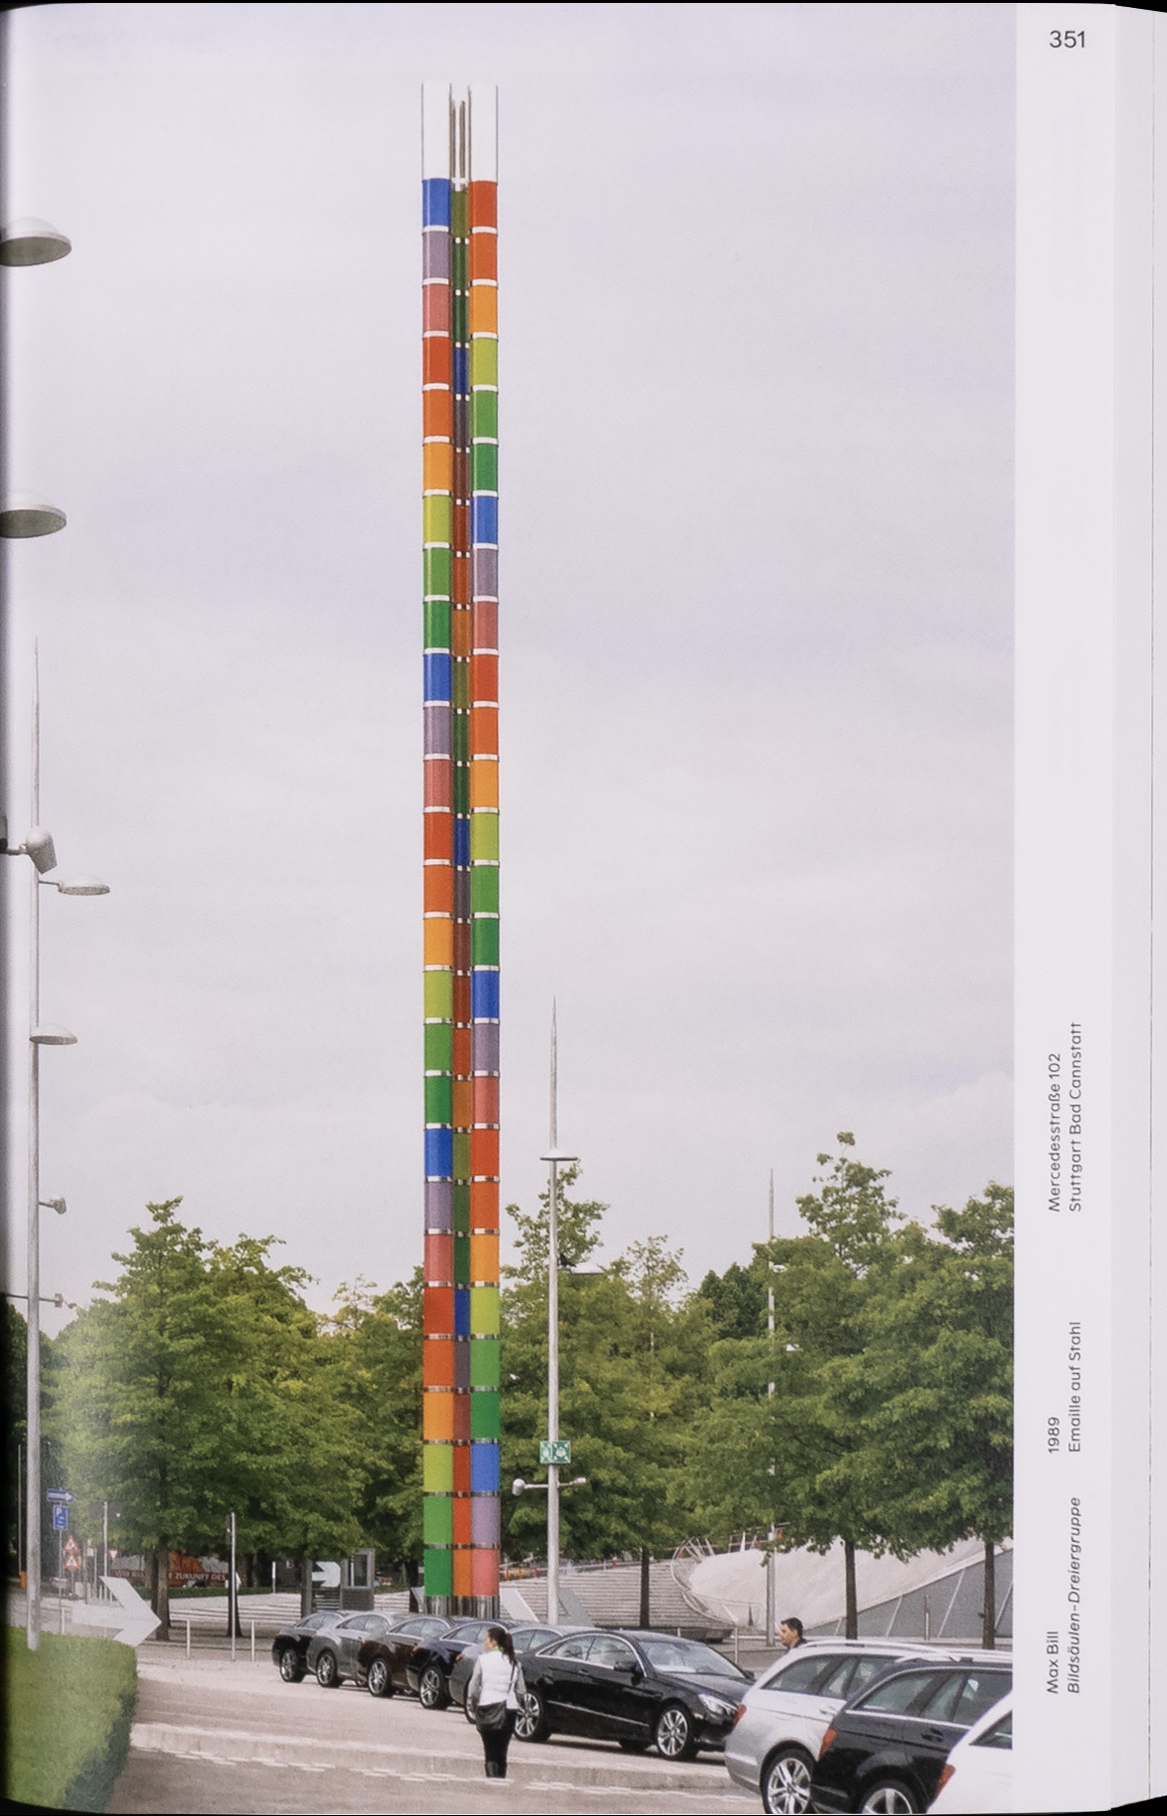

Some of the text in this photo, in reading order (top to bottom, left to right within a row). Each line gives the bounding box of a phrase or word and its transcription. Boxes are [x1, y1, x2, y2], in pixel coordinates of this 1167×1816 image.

[1049, 30, 1085, 49] 351
[1047, 1054, 1060, 1212] Mercedesstraße 102
[1068, 1022, 1082, 1211] Stuttgart Bad Cannstatt
[1047, 1417, 1060, 1453] 1989
[1068, 1322, 1081, 1452] Emaille auf Stahl
[1067, 1498, 1082, 1693] Bildsäulen-Dreiergruppe
[1046, 1632, 1059, 1694] Max Bill
